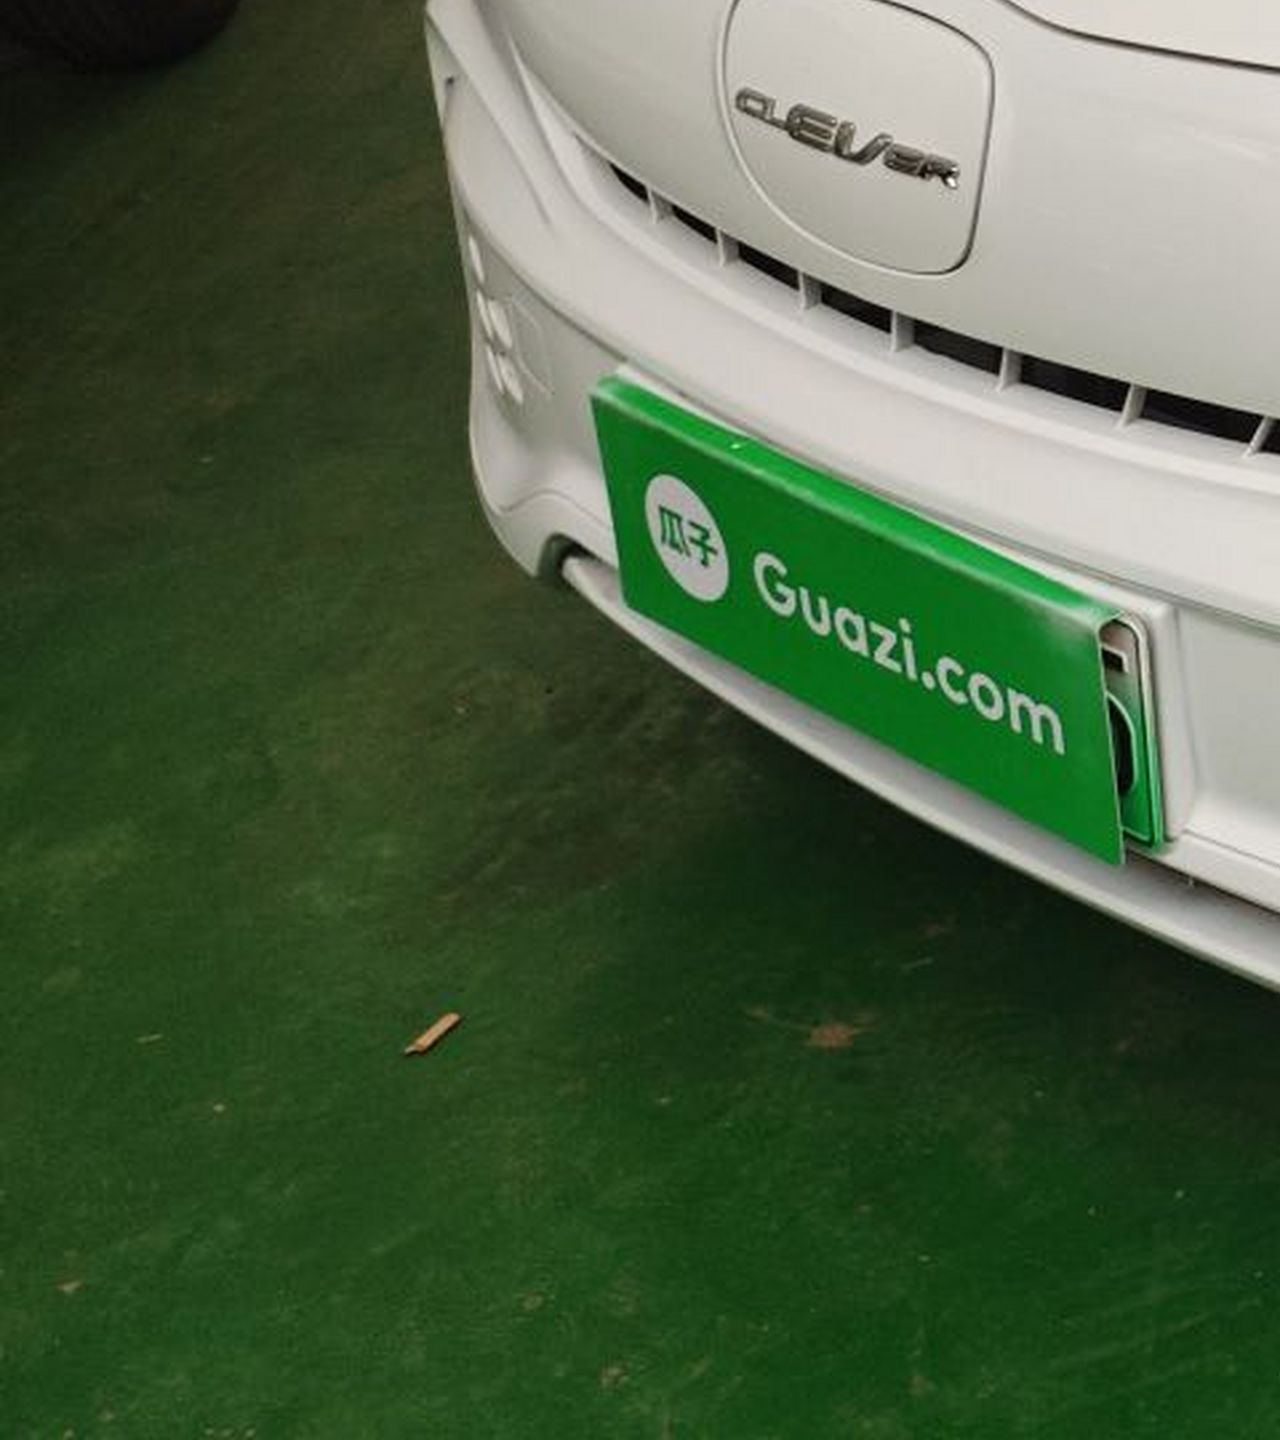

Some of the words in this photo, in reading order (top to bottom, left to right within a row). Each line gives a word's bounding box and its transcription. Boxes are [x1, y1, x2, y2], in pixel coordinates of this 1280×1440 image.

[735, 87, 960, 189] CLEVER
[659, 504, 718, 568] 瓜子
[753, 552, 1066, 755] Guazi.com
